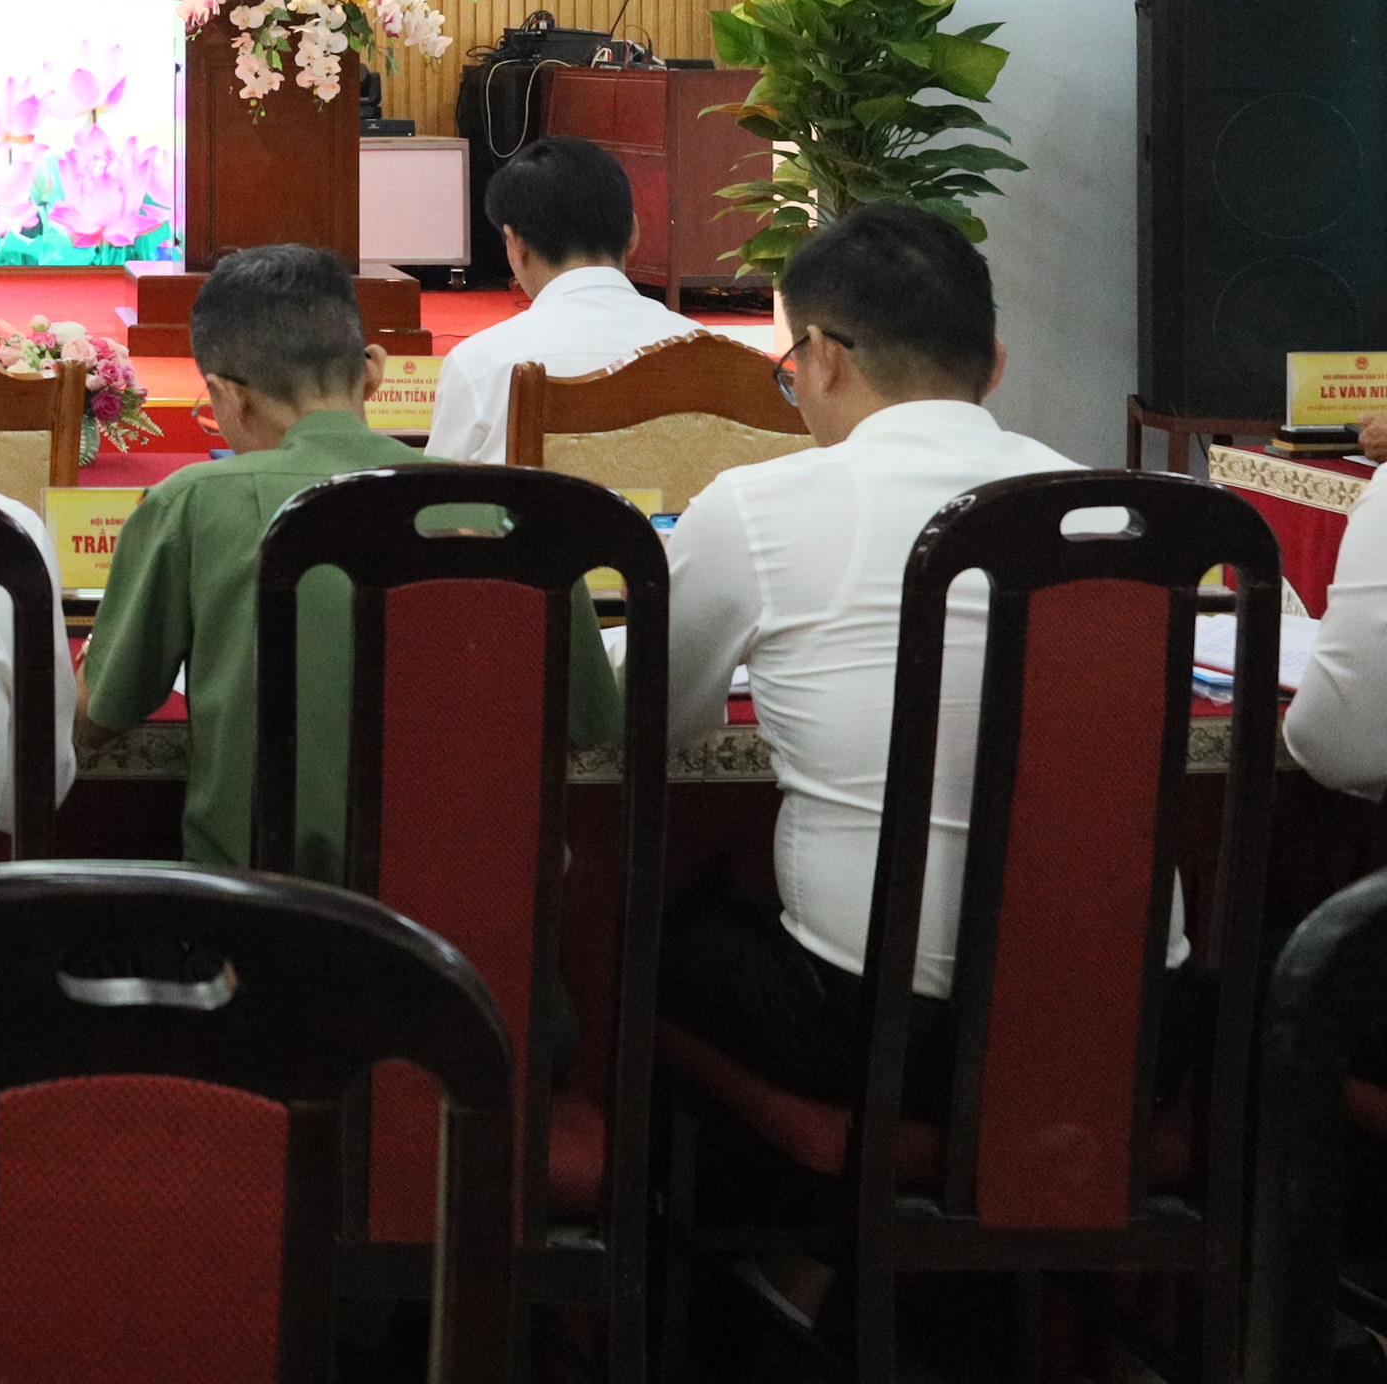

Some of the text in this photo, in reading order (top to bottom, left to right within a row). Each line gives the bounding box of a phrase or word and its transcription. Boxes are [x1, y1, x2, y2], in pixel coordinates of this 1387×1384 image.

[368, 386, 402, 402] GUYỄN
[1320, 384, 1387, 398] LÊ VĂN NI
